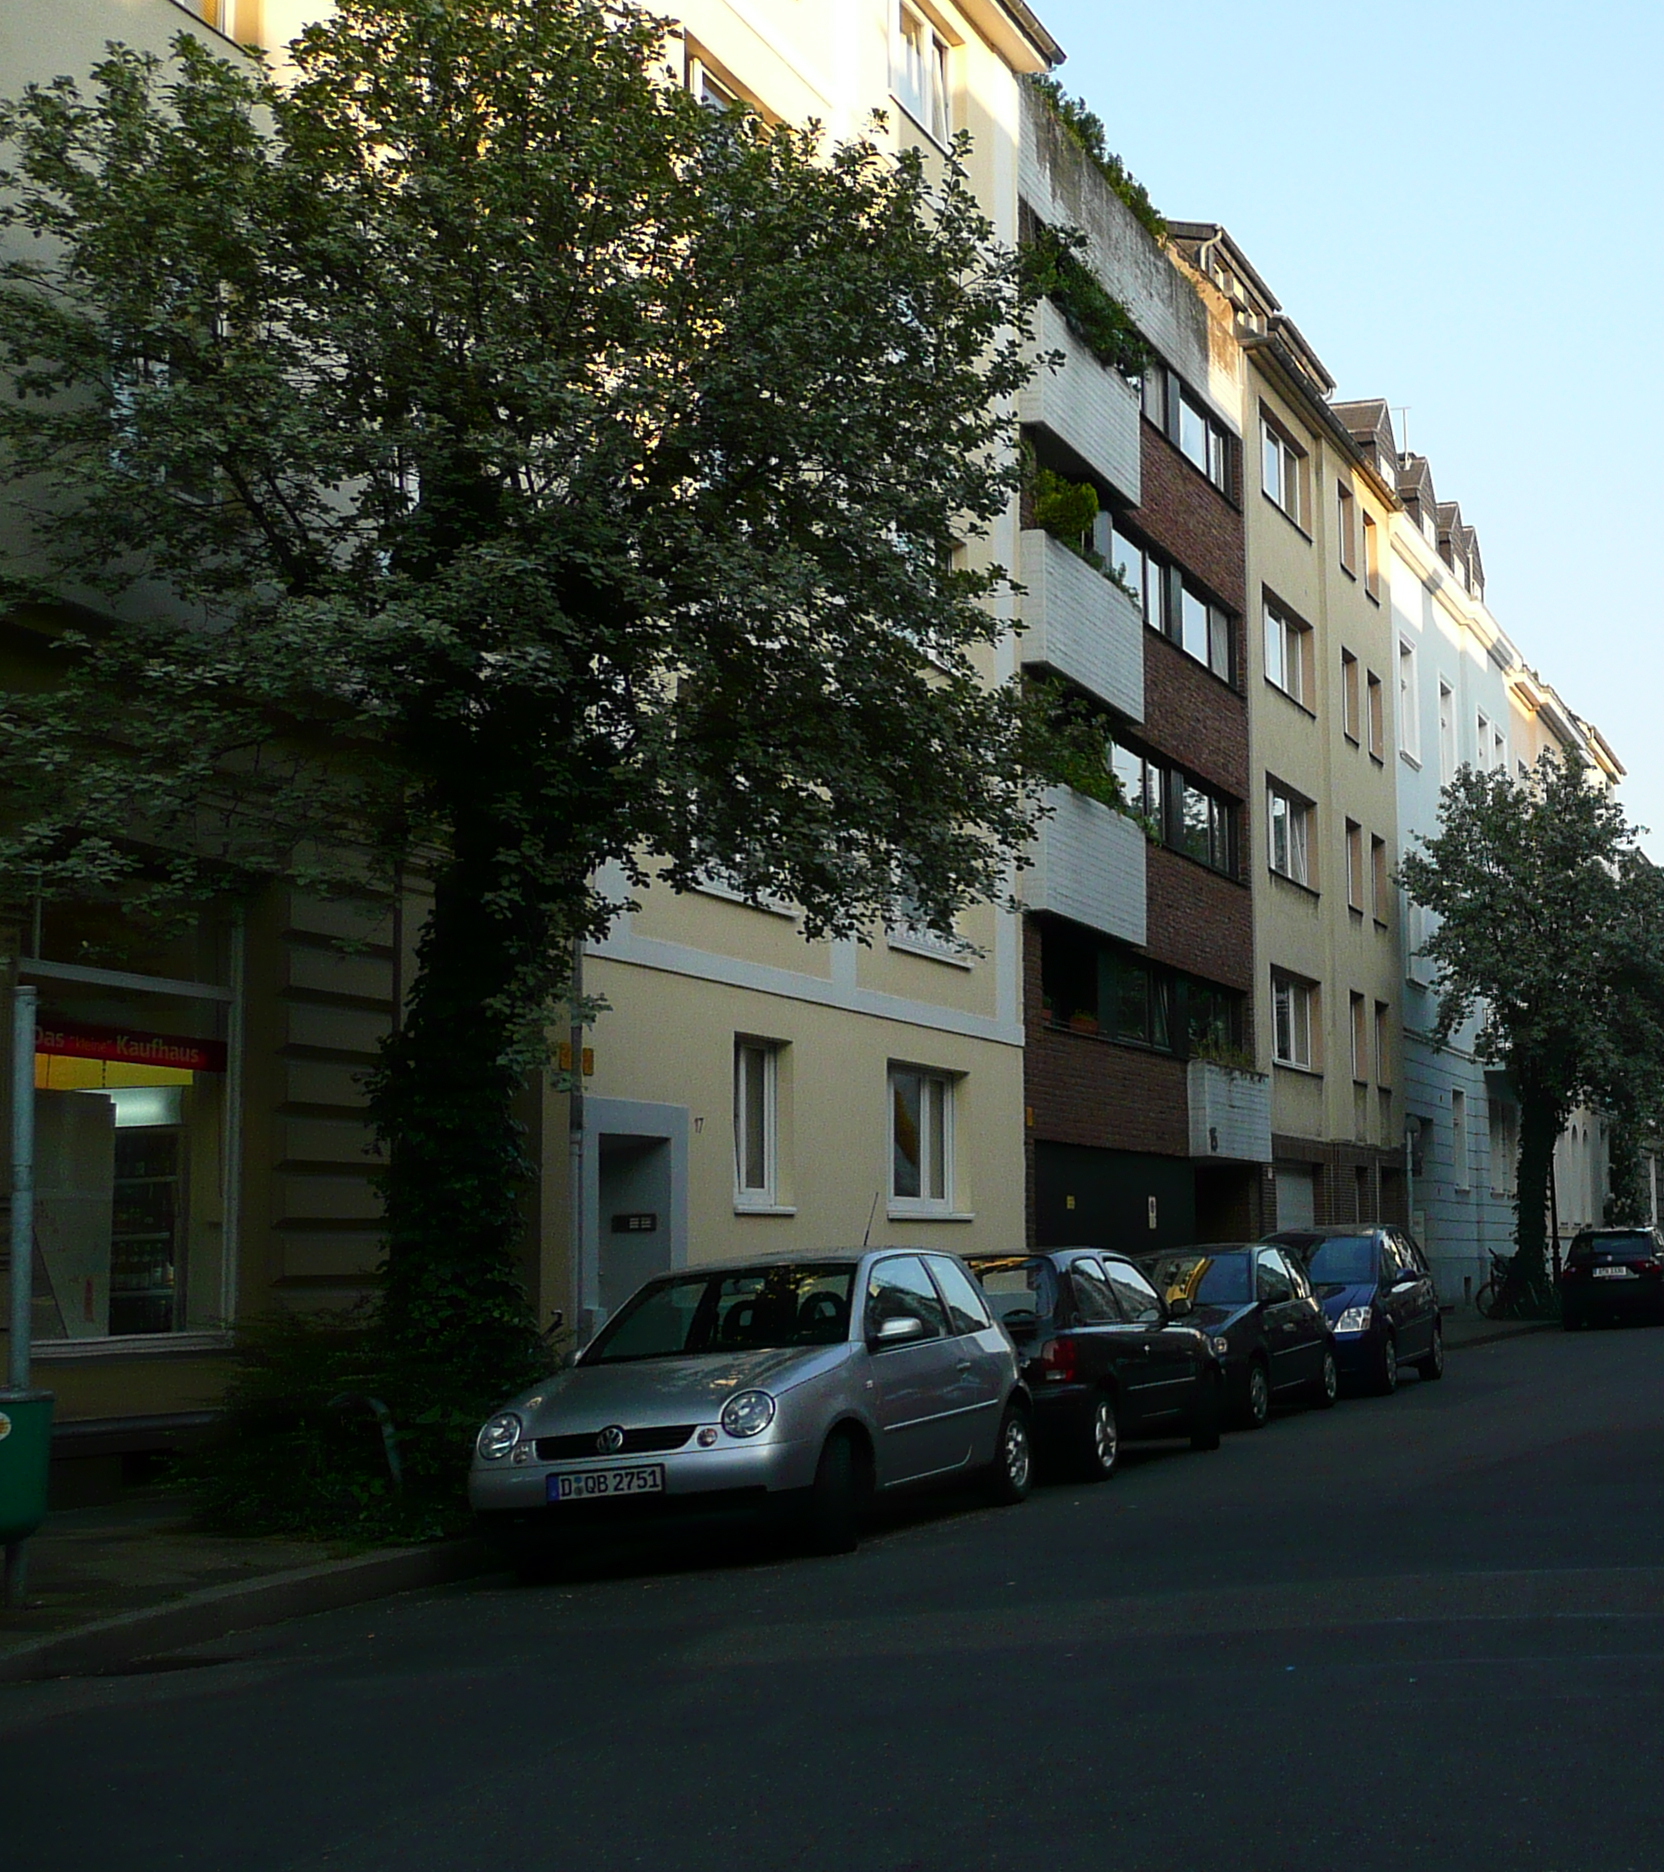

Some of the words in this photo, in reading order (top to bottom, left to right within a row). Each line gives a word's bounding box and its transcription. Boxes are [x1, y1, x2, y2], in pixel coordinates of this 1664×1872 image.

[115, 1034, 200, 1063] Kaufhaus
[694, 1117, 704, 1134] 17
[561, 1478, 572, 1497] D
[584, 1474, 609, 1495] QB
[613, 1469, 660, 1492] 2751
